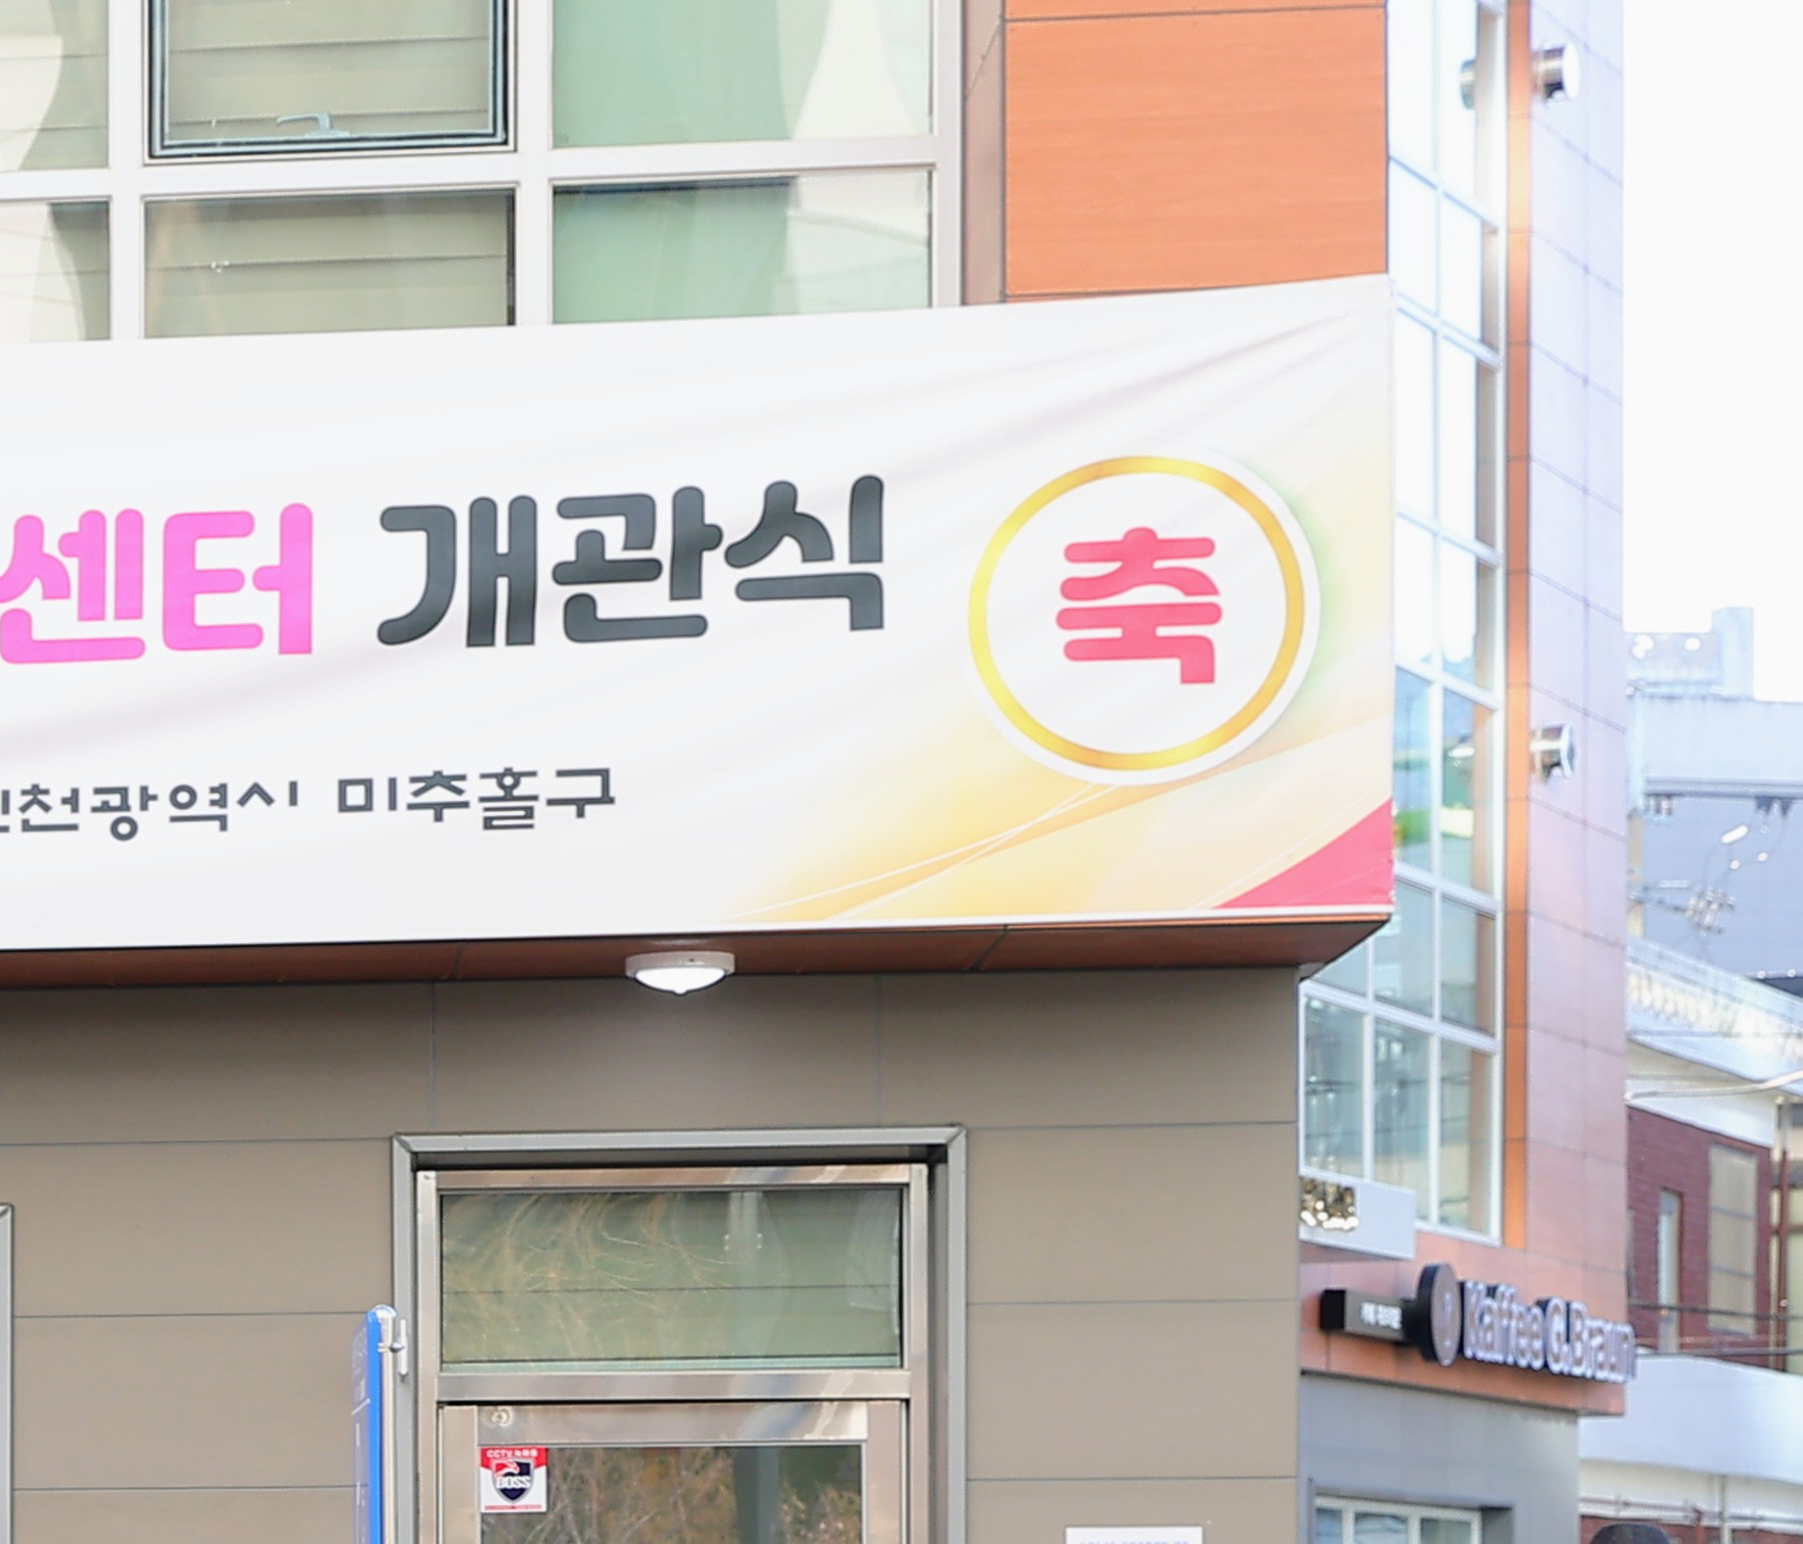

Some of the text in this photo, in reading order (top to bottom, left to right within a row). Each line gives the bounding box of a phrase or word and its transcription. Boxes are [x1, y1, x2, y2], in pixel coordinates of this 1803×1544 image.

[377, 474, 885, 649] 개관식
[1060, 525, 1224, 685] 축
[336, 766, 617, 832] 미추홀구
[1464, 1280, 1543, 1372] Kaffee
[486, 1449, 513, 1458] CCTV
[496, 1475, 531, 1490] BOSS
